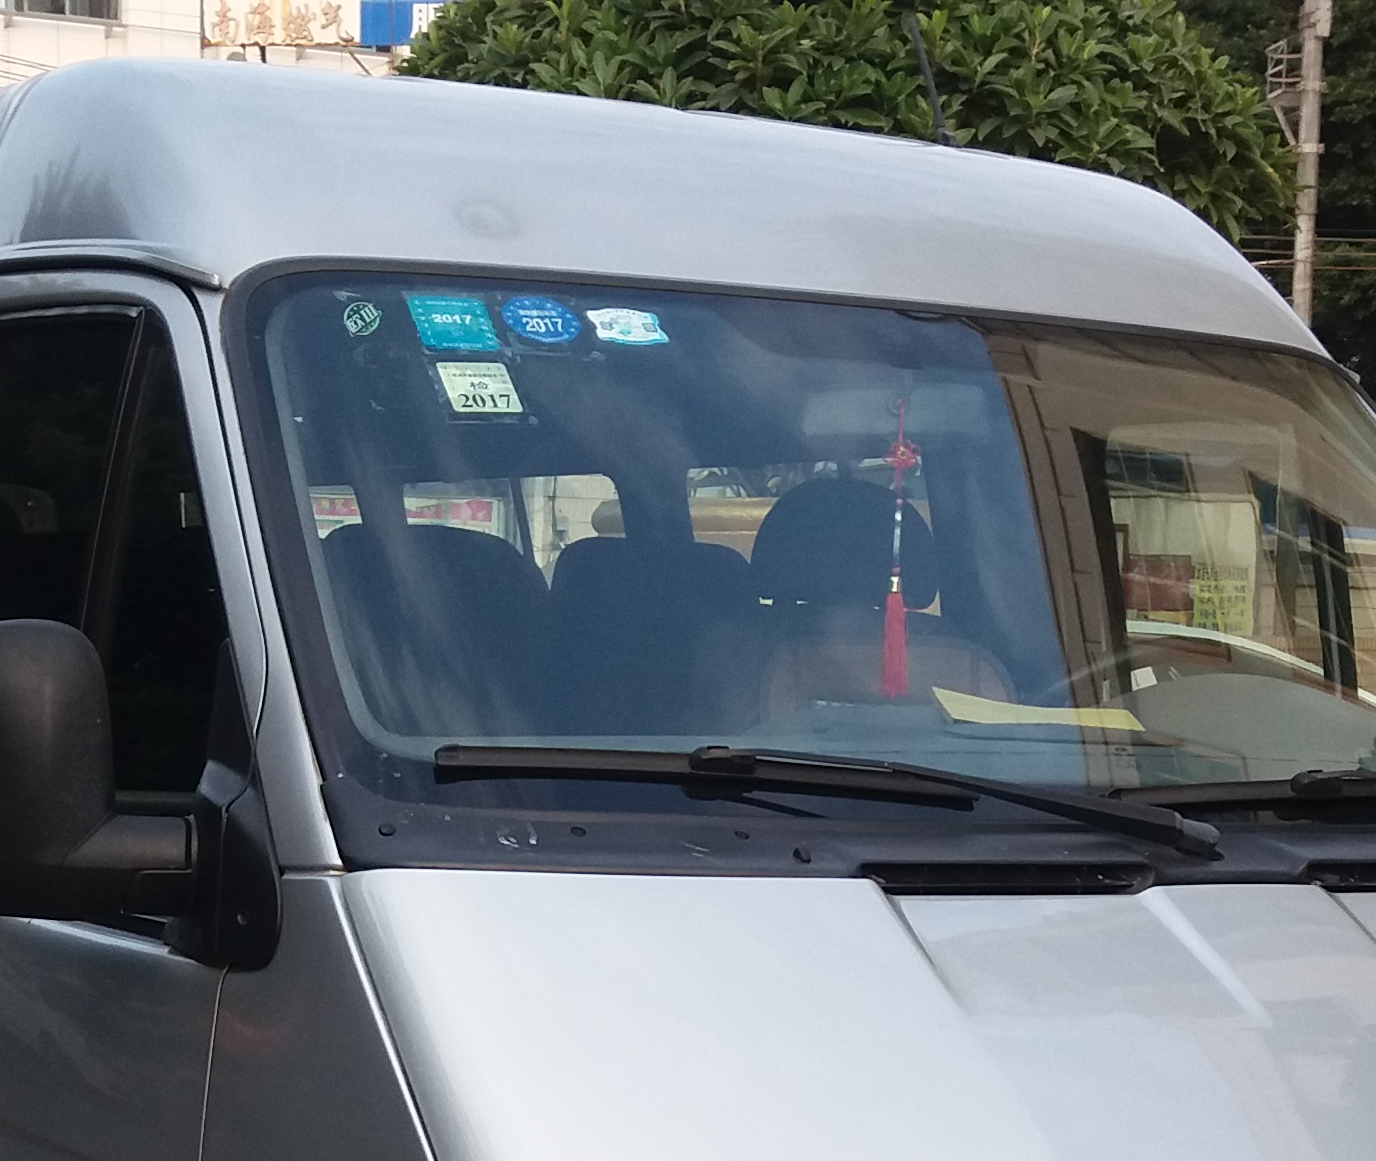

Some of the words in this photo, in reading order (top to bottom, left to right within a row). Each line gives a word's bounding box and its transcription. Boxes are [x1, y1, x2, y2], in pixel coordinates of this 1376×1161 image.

[431, 313, 472, 325] 2017
[522, 317, 563, 333] 2017
[457, 393, 511, 409] 2017
